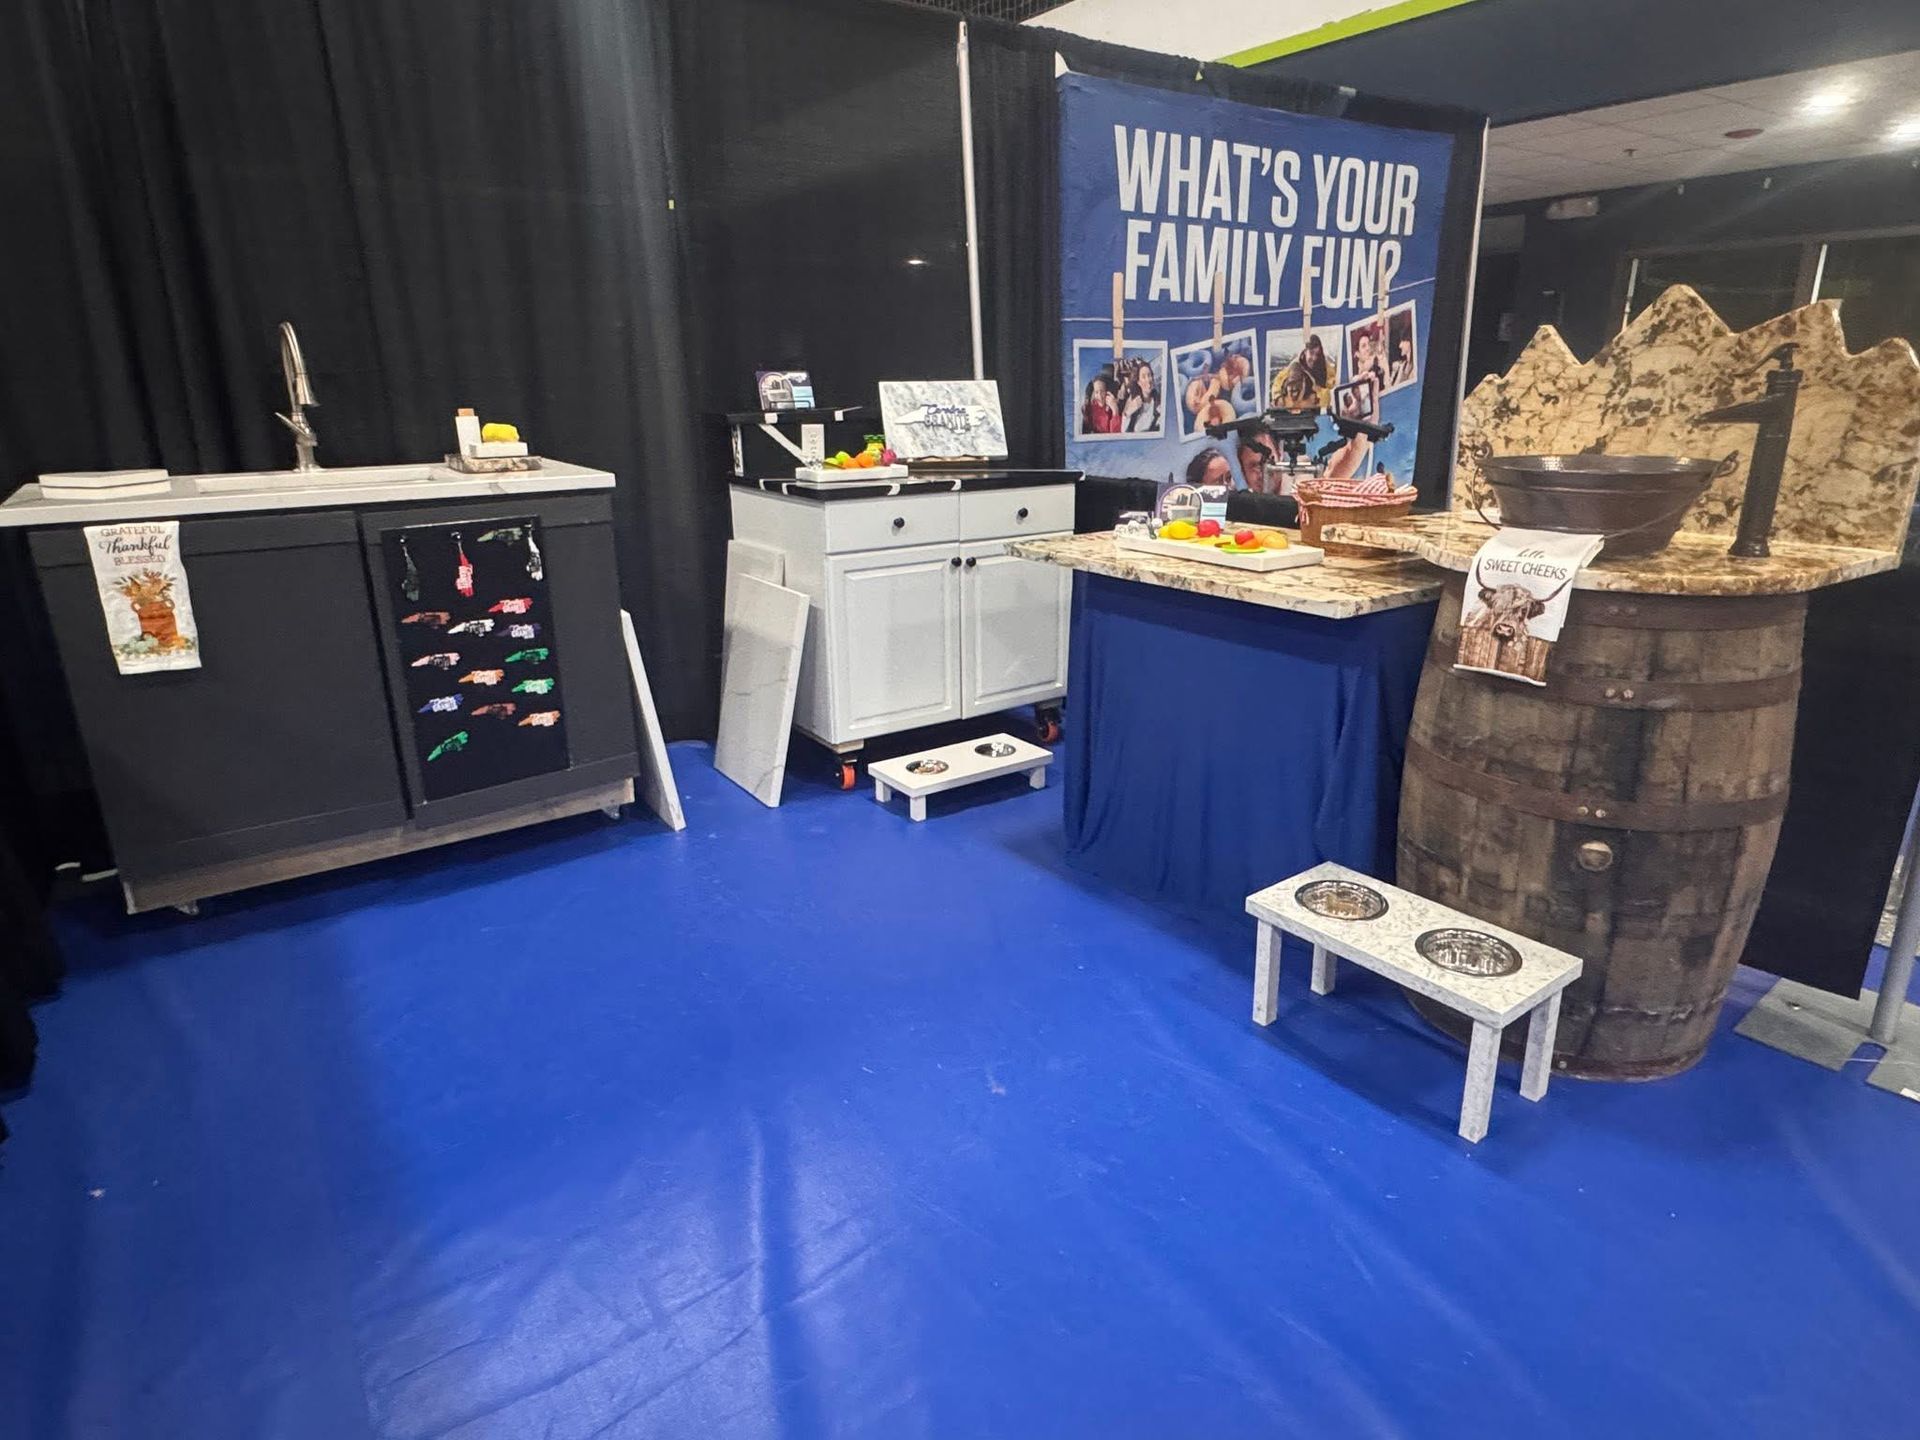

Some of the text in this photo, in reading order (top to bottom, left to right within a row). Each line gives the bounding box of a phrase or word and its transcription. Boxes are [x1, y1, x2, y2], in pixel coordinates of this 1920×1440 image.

[1114, 124, 1419, 236] WHAT'S YOUR
[1124, 219, 1401, 310] FAMILY FUN?
[101, 525, 165, 537] GRATEFUL
[99, 535, 172, 556] Thankful
[114, 554, 166, 566] BLESSED
[1484, 558, 1568, 581] SWEET CHEEKS
